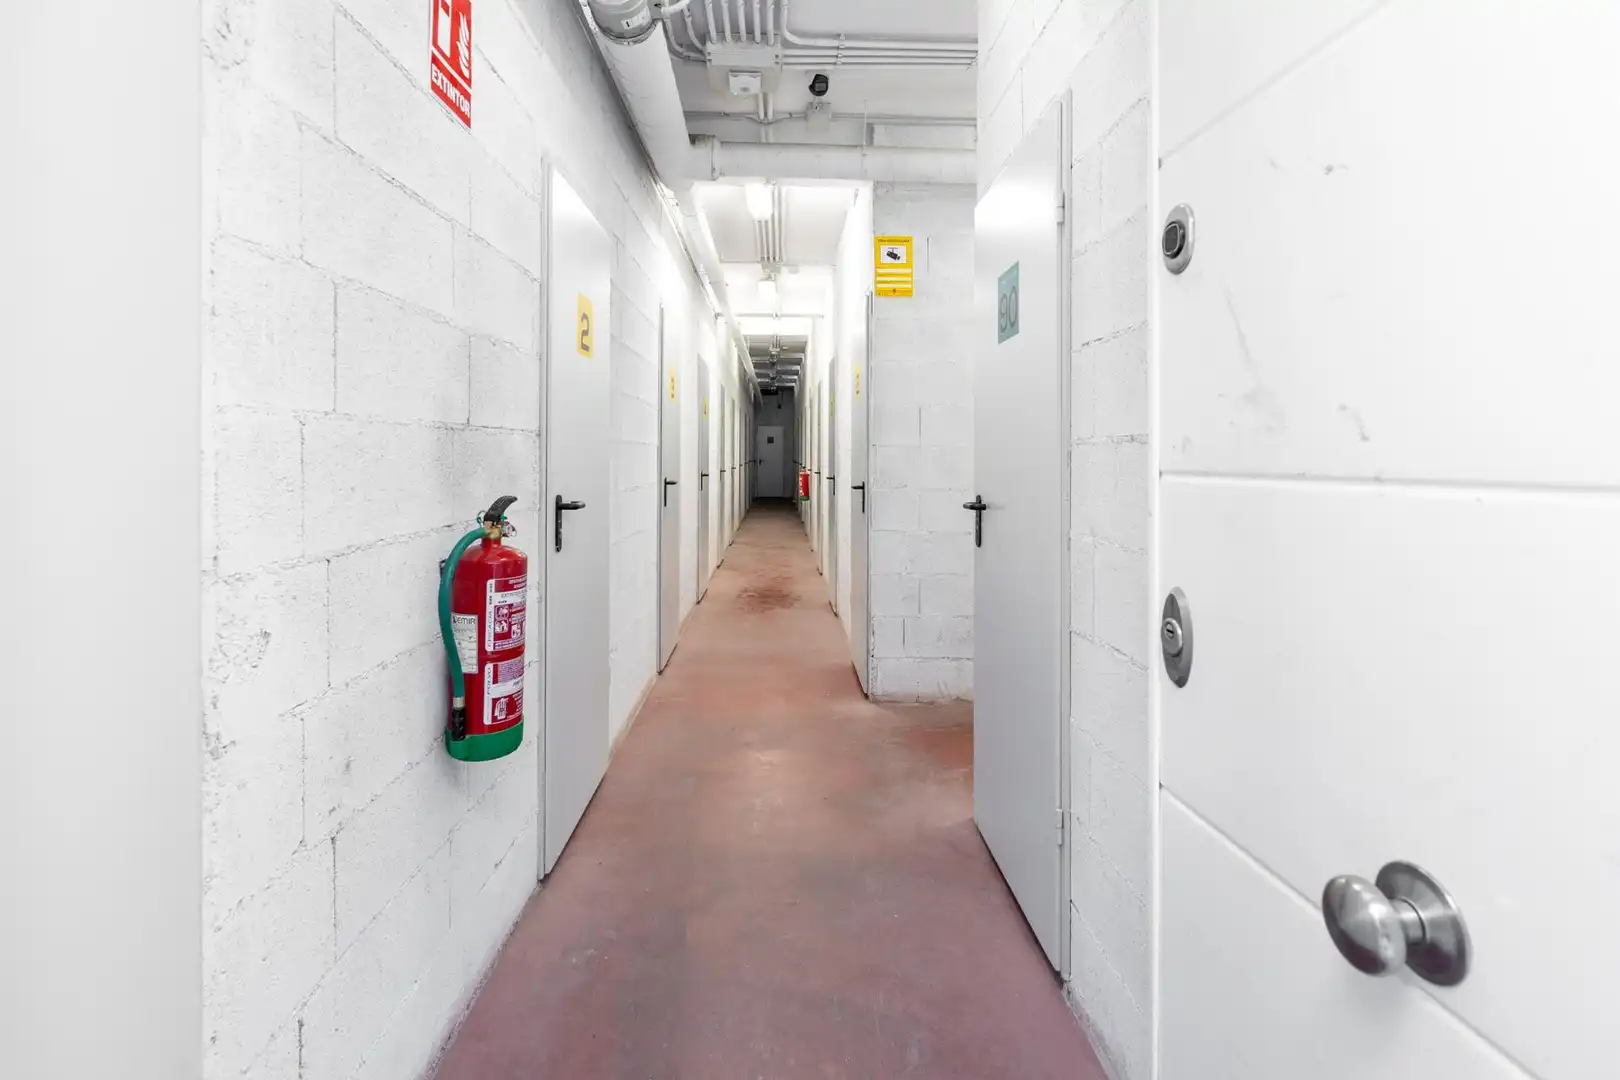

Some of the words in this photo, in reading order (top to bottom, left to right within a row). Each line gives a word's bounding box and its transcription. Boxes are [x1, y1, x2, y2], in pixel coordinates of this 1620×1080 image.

[431, 63, 471, 118] EXTINTOR
[580, 312, 590, 352] 2
[999, 285, 1018, 334] 90
